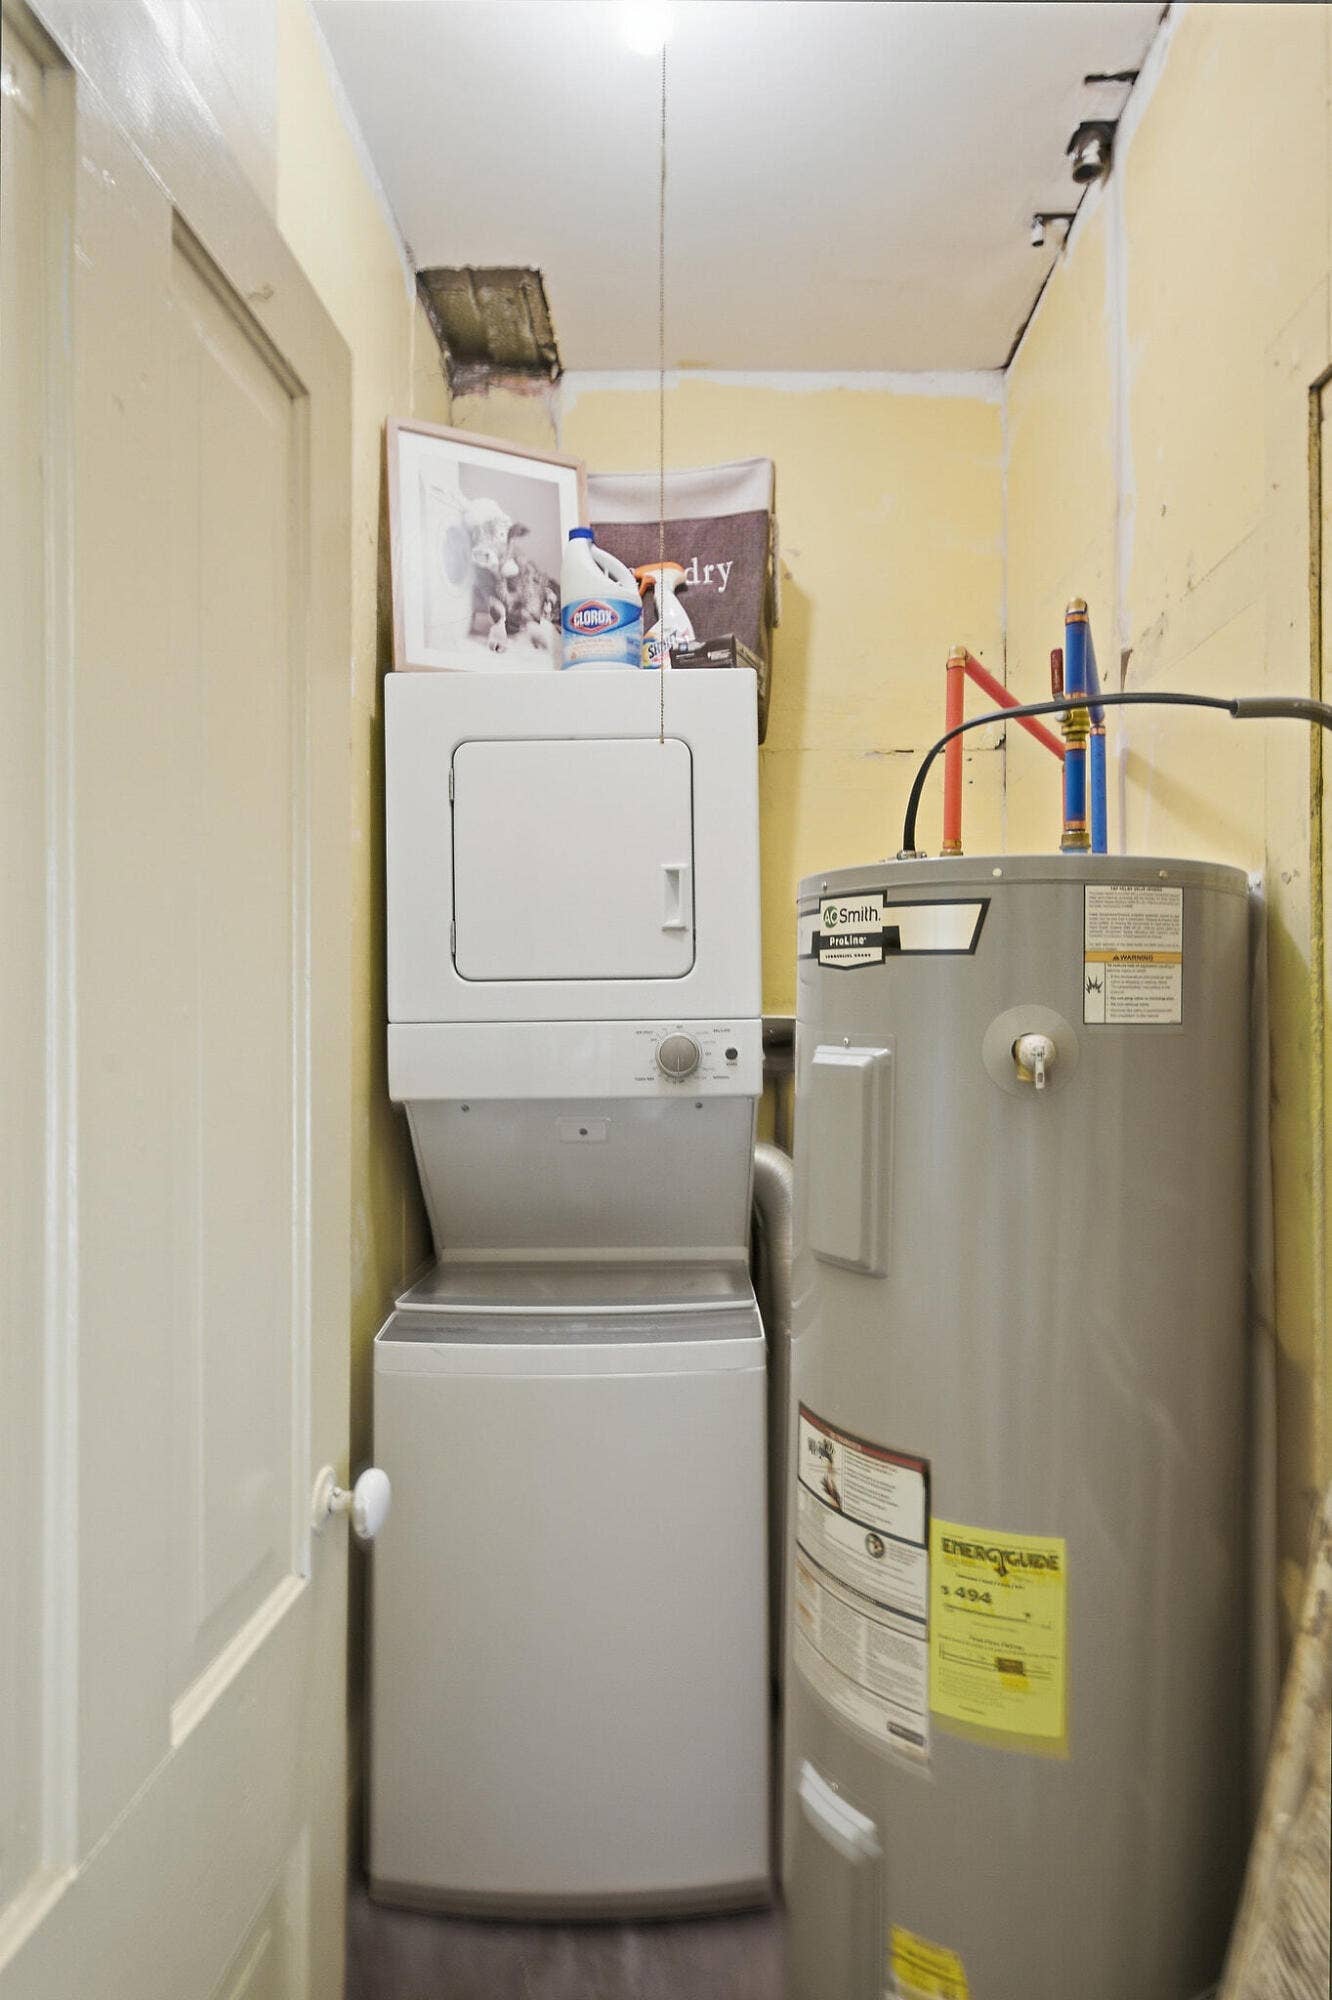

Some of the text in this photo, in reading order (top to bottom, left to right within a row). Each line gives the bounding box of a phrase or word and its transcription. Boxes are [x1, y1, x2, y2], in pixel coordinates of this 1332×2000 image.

[685, 557, 733, 592] dry
[573, 609, 612, 627] CLOROX
[955, 1586, 992, 1604] 494
